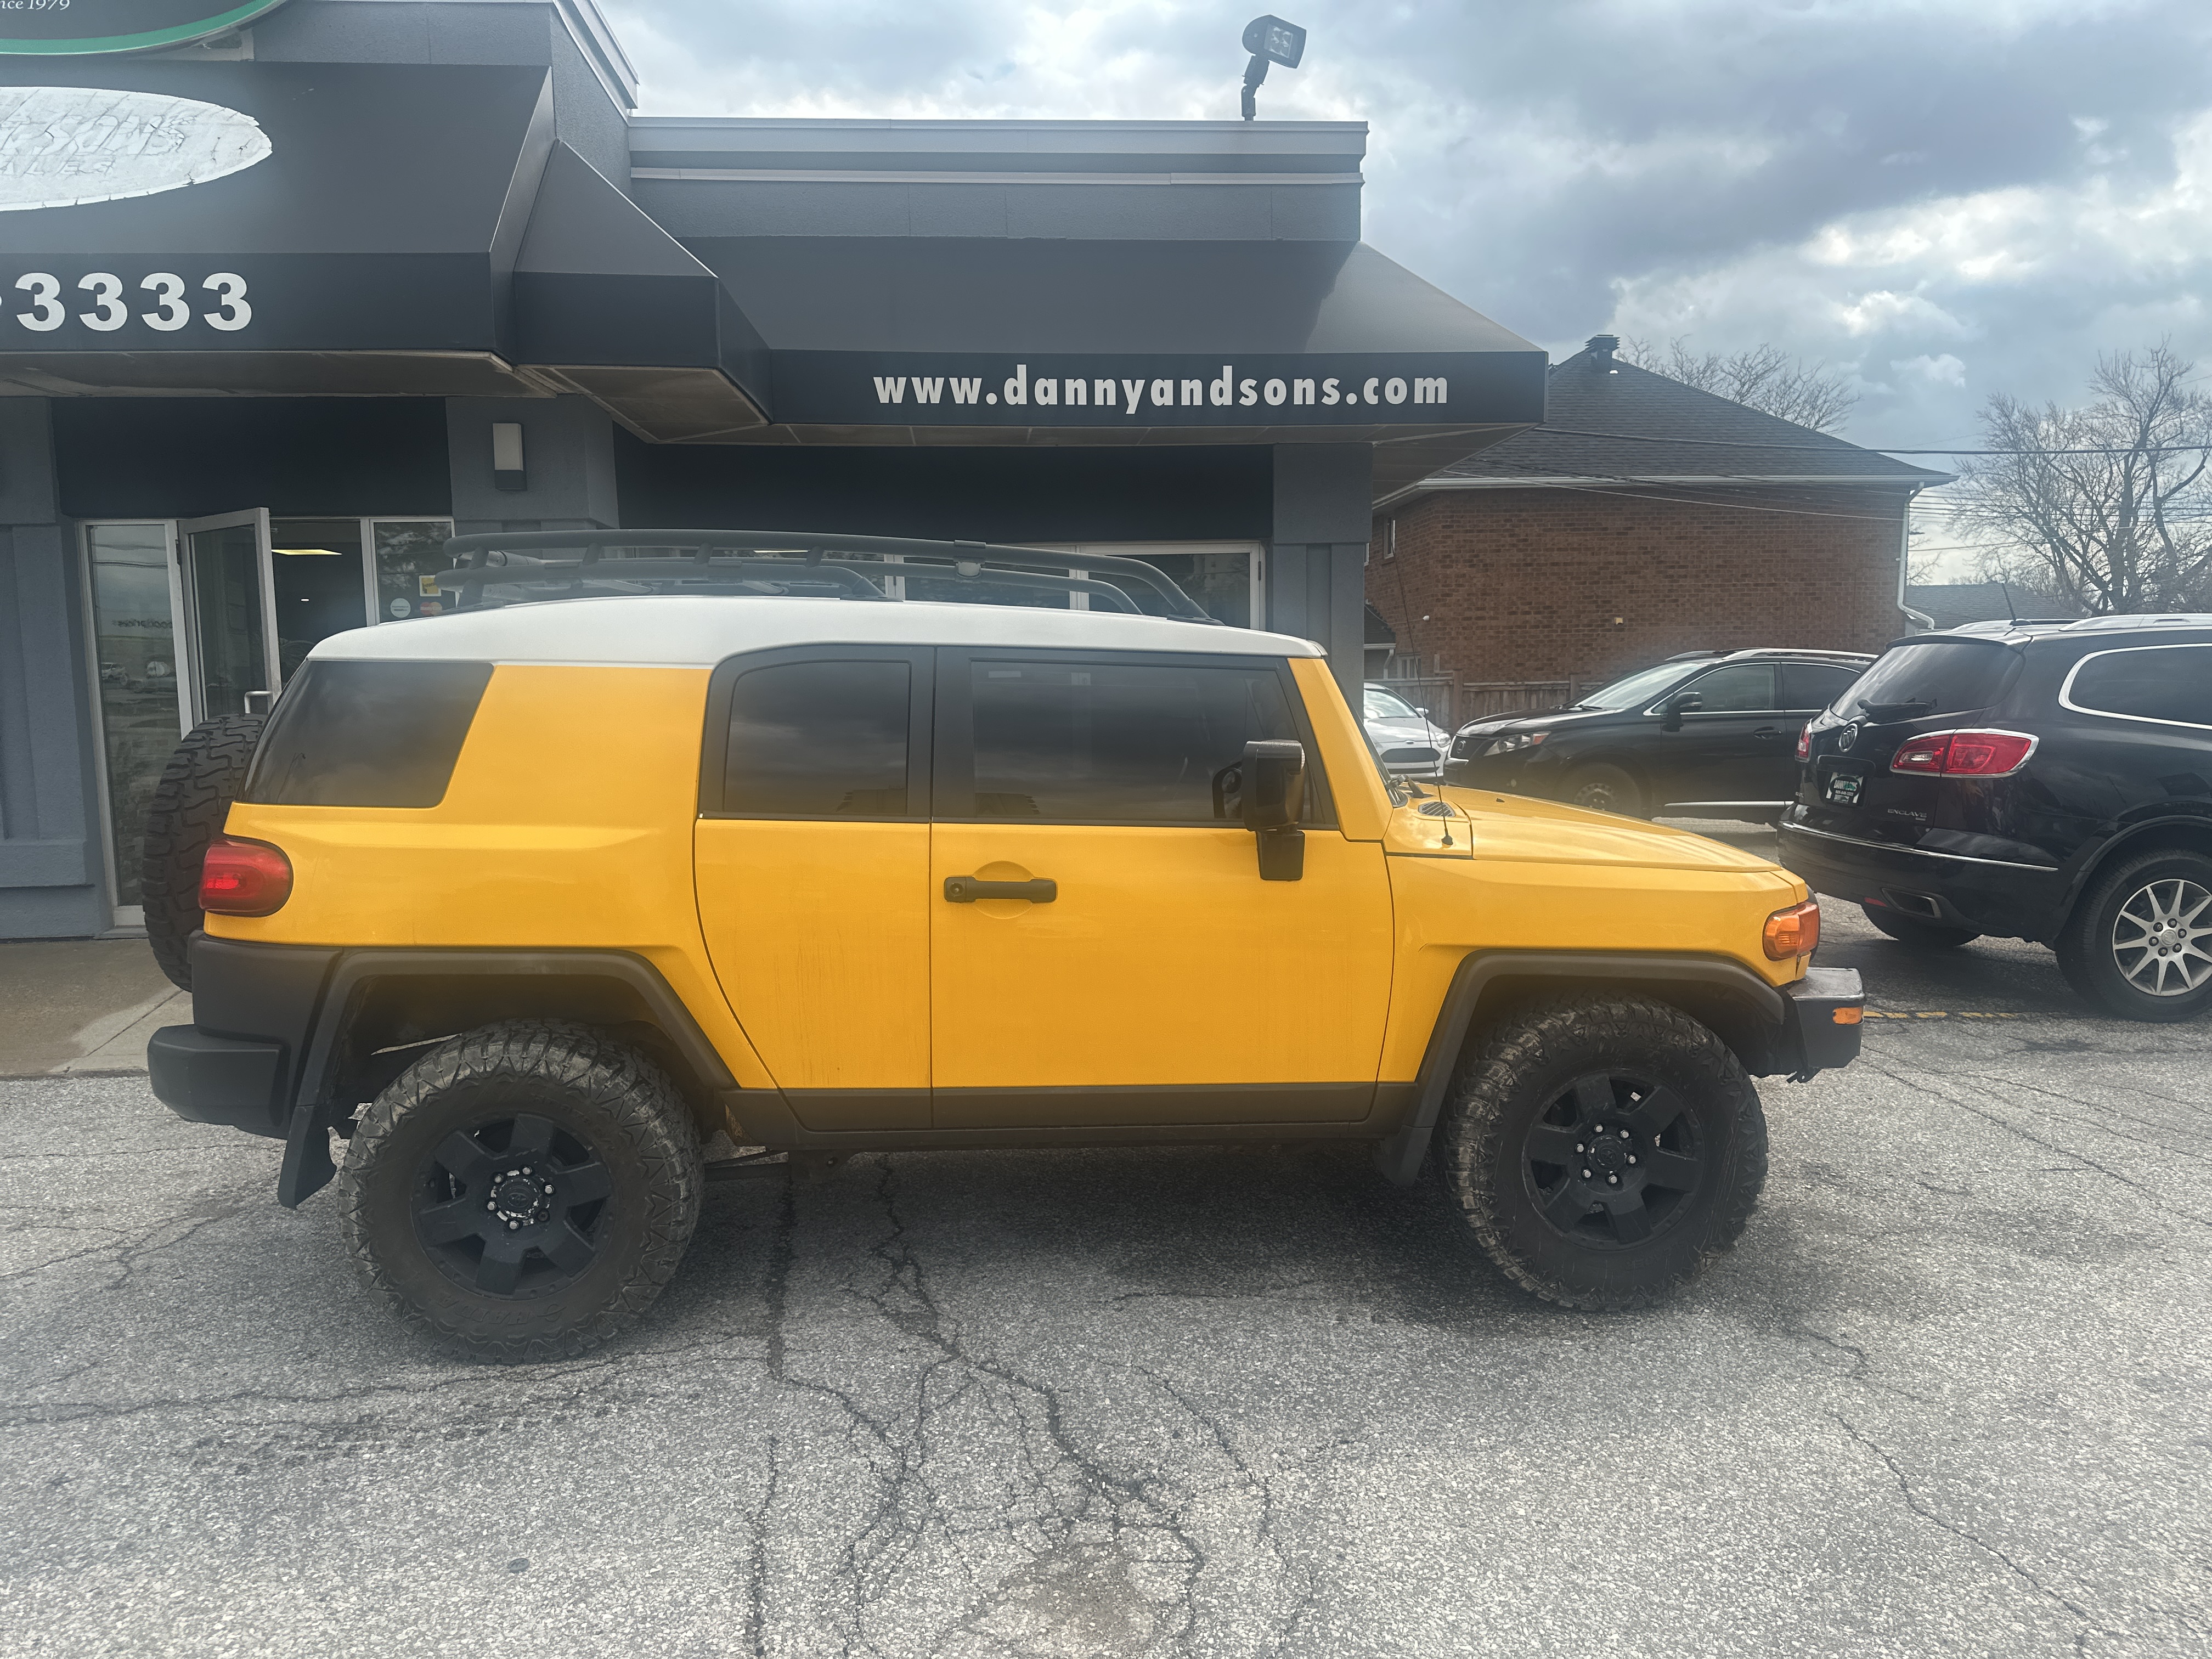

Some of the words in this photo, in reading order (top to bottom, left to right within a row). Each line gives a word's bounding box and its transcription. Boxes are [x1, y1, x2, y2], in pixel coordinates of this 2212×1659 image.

[27, 0, 70, 10] 1979
[0, 272, 252, 331] 3333
[873, 364, 1448, 414] www.dannyandsons.com
[1887, 809, 1927, 818] ENCLAVE
